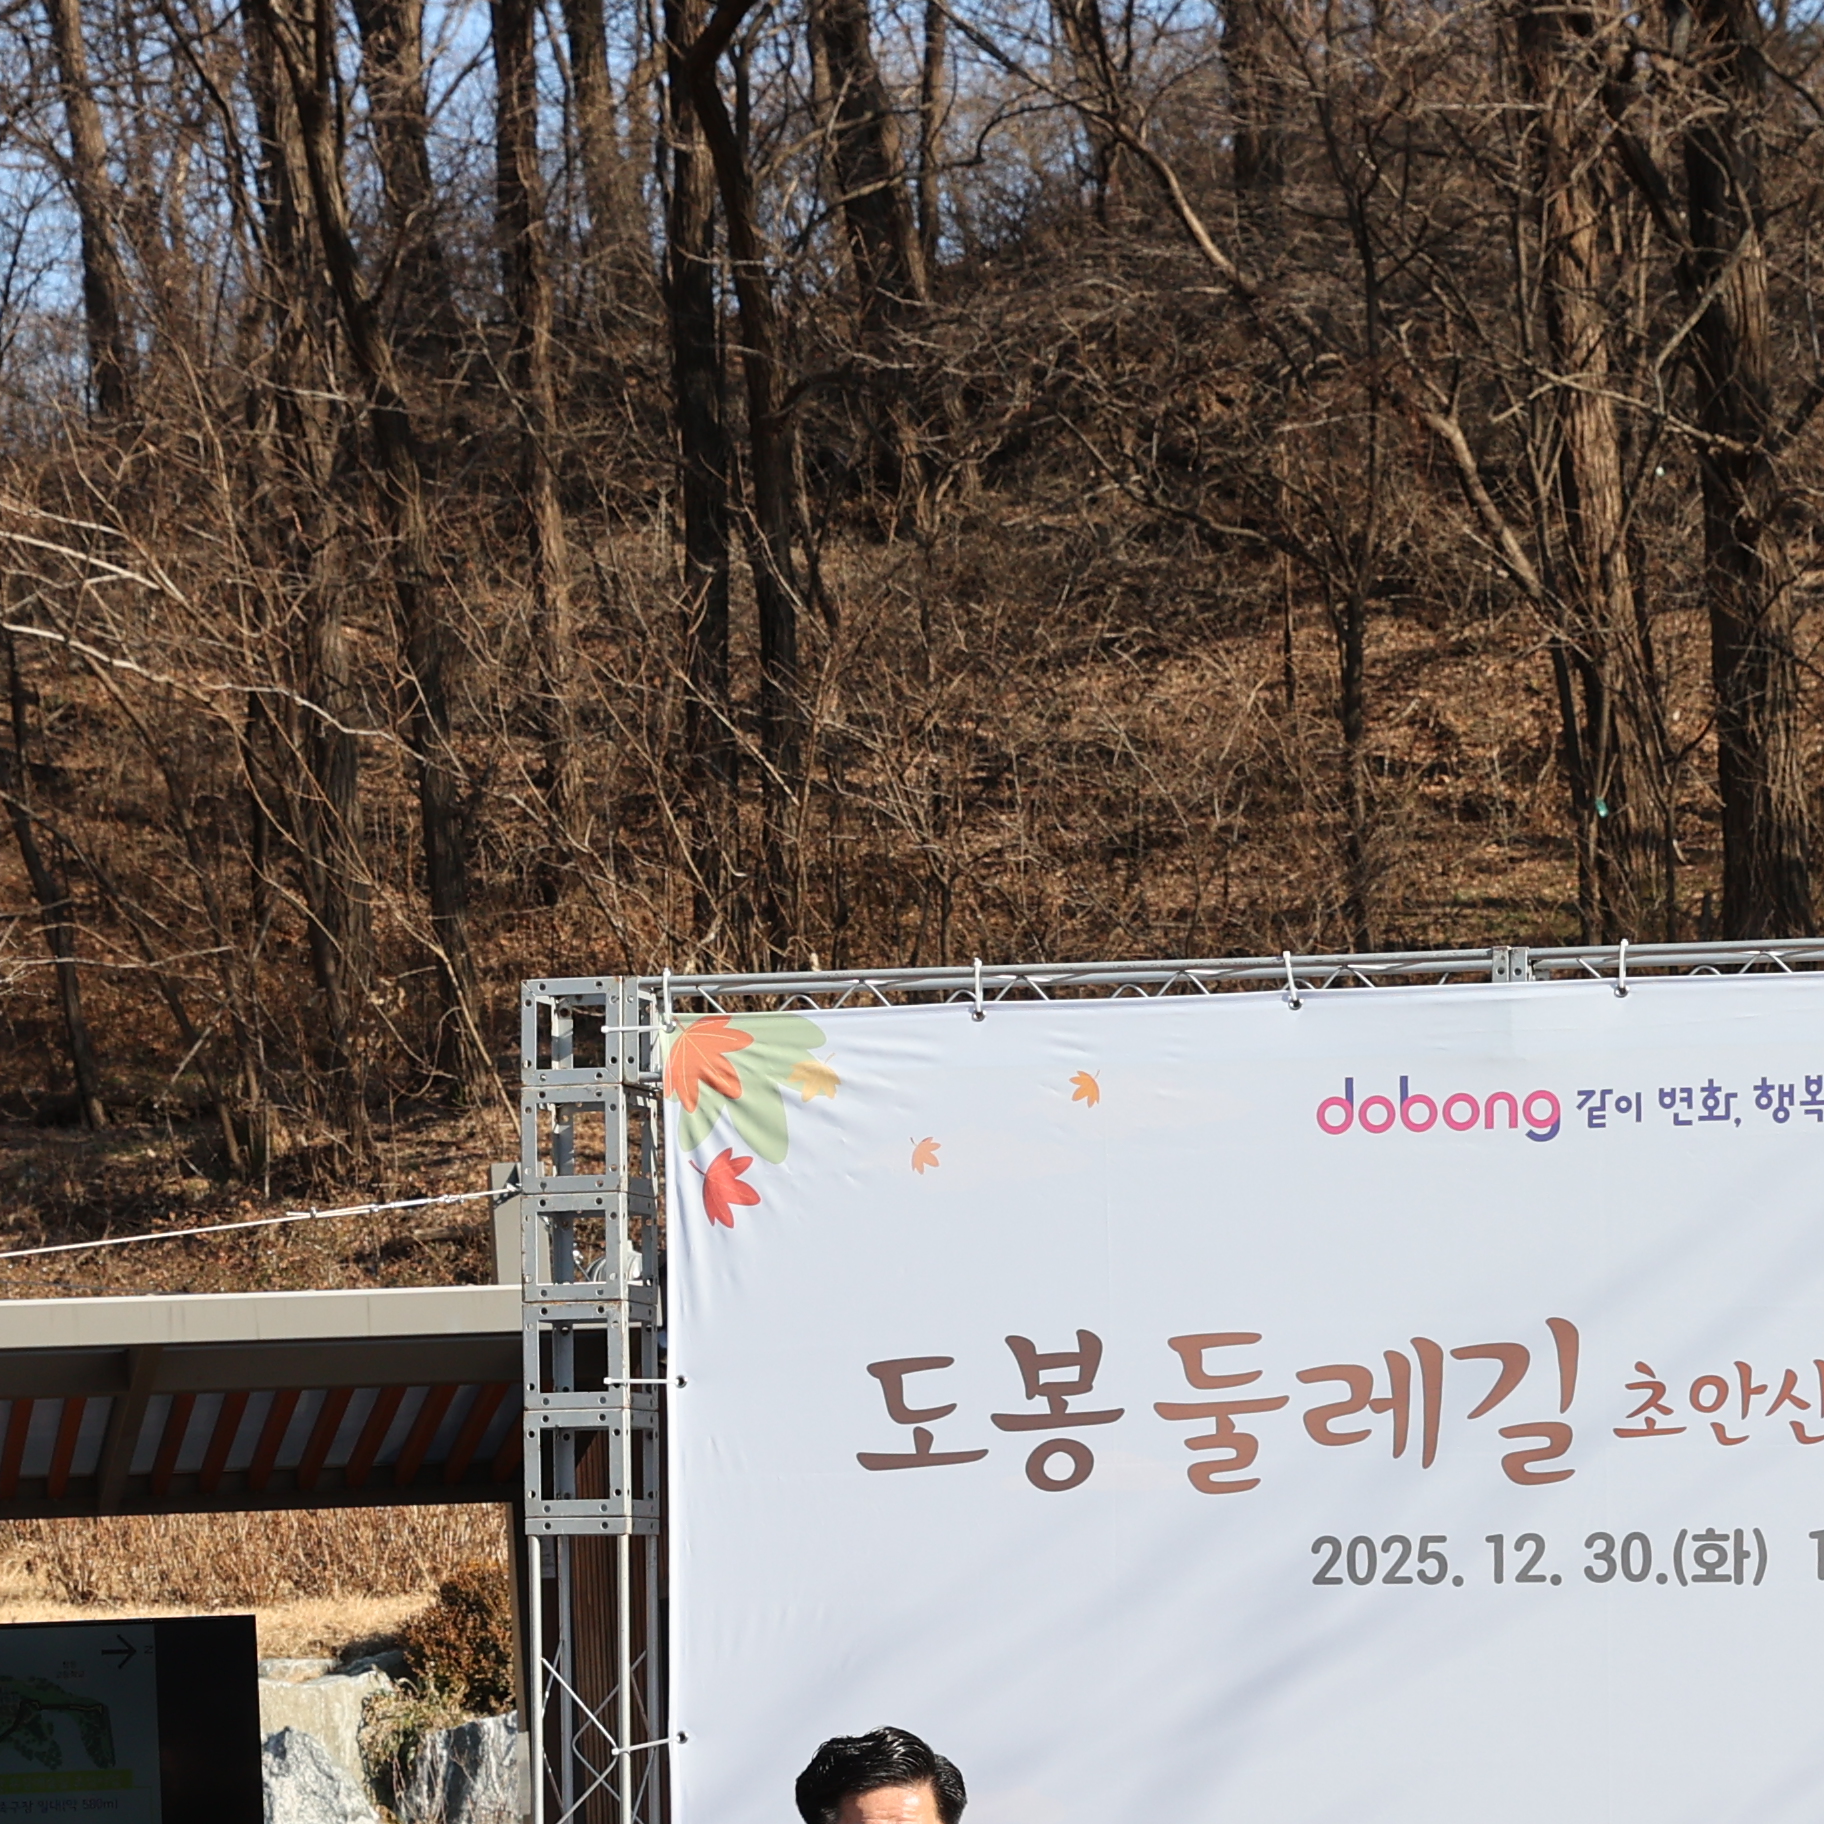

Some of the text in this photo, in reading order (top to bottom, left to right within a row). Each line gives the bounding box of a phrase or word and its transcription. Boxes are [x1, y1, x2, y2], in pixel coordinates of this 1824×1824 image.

[1317, 1076, 1561, 1142] dobong
[1576, 1088, 1642, 1129] 같이
[1659, 1079, 1742, 1128] 변화,
[856, 1329, 1126, 1493] 도봉
[1152, 1316, 1580, 1495] 둘레길
[1310, 1534, 1464, 1588] 2025.
[1484, 1532, 1563, 1587] 12.
[1583, 1527, 1768, 1589] 30.(화)
